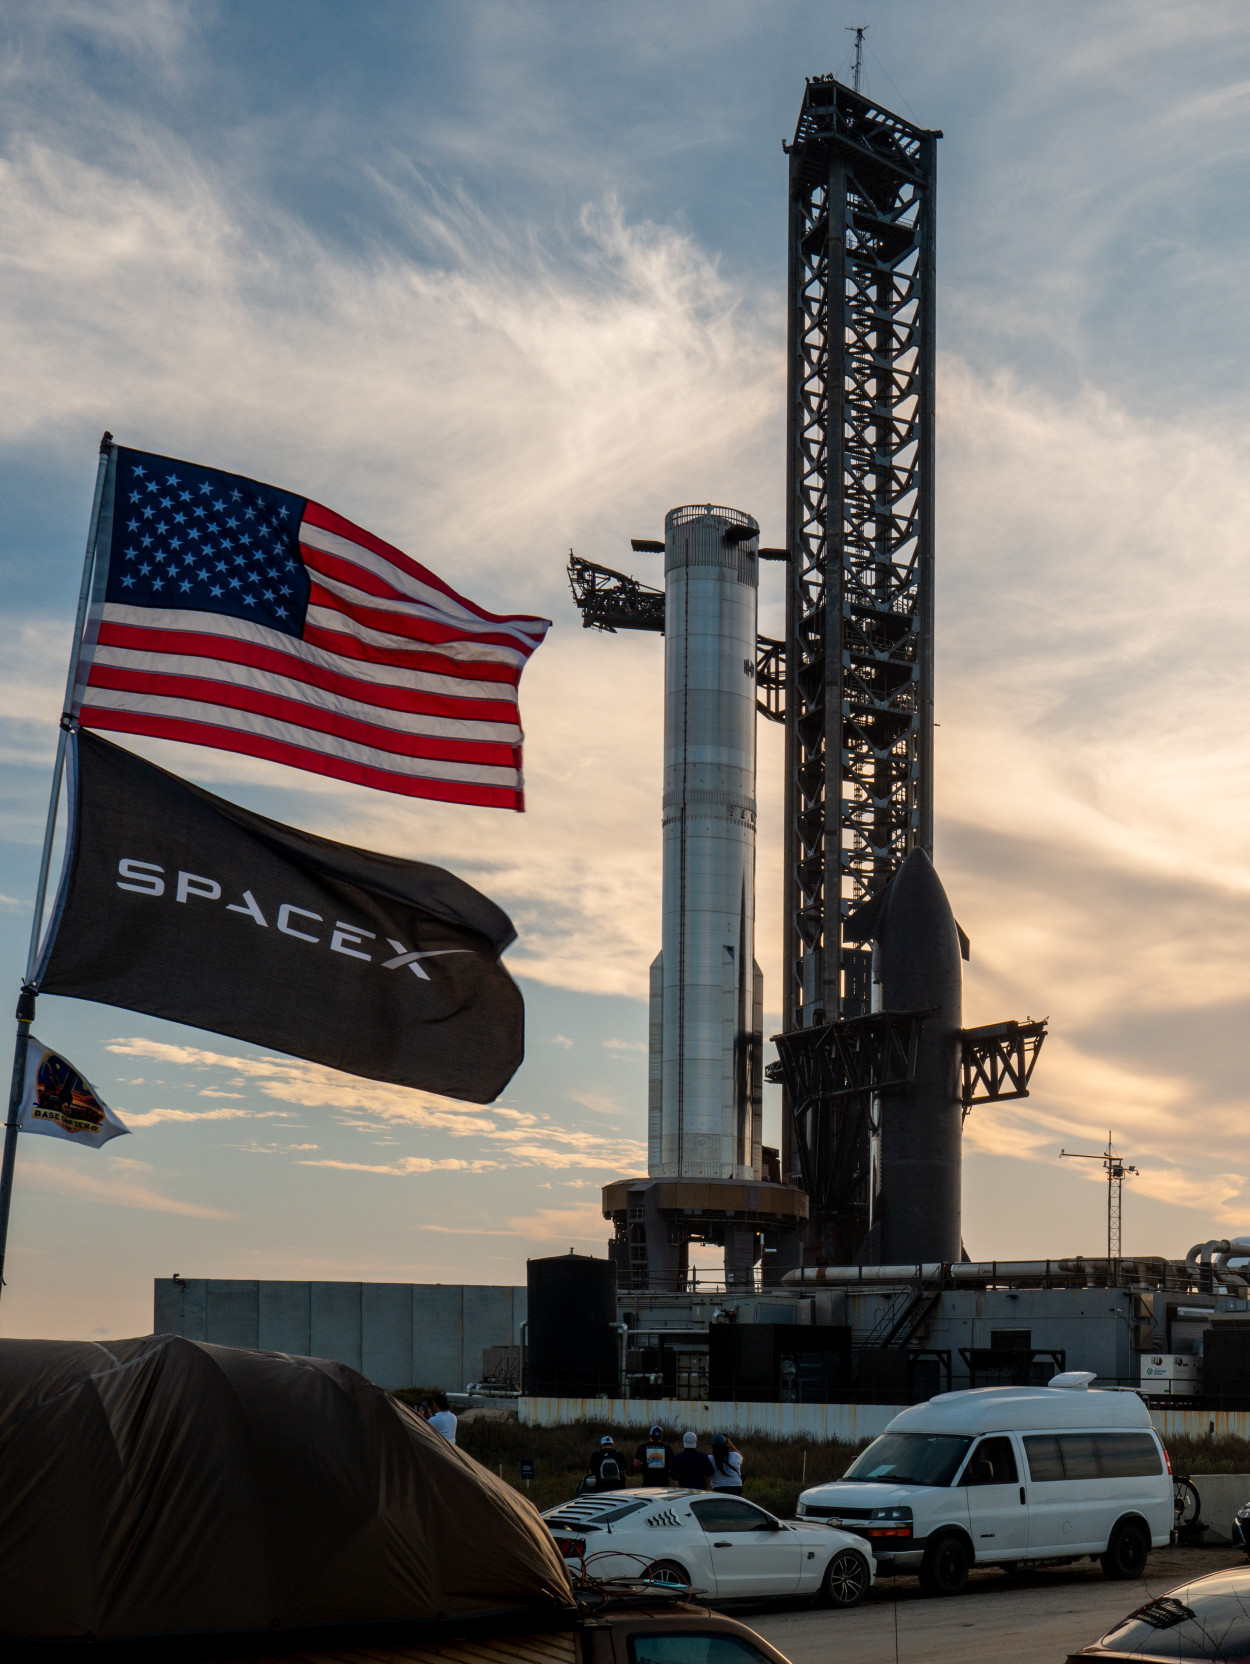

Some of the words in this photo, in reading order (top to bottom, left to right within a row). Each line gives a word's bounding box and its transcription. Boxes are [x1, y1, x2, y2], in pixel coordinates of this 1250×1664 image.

[116, 858, 479, 982] SPACEX
[34, 1110, 60, 1120] BASE
[74, 1121, 98, 1131] ZERO
